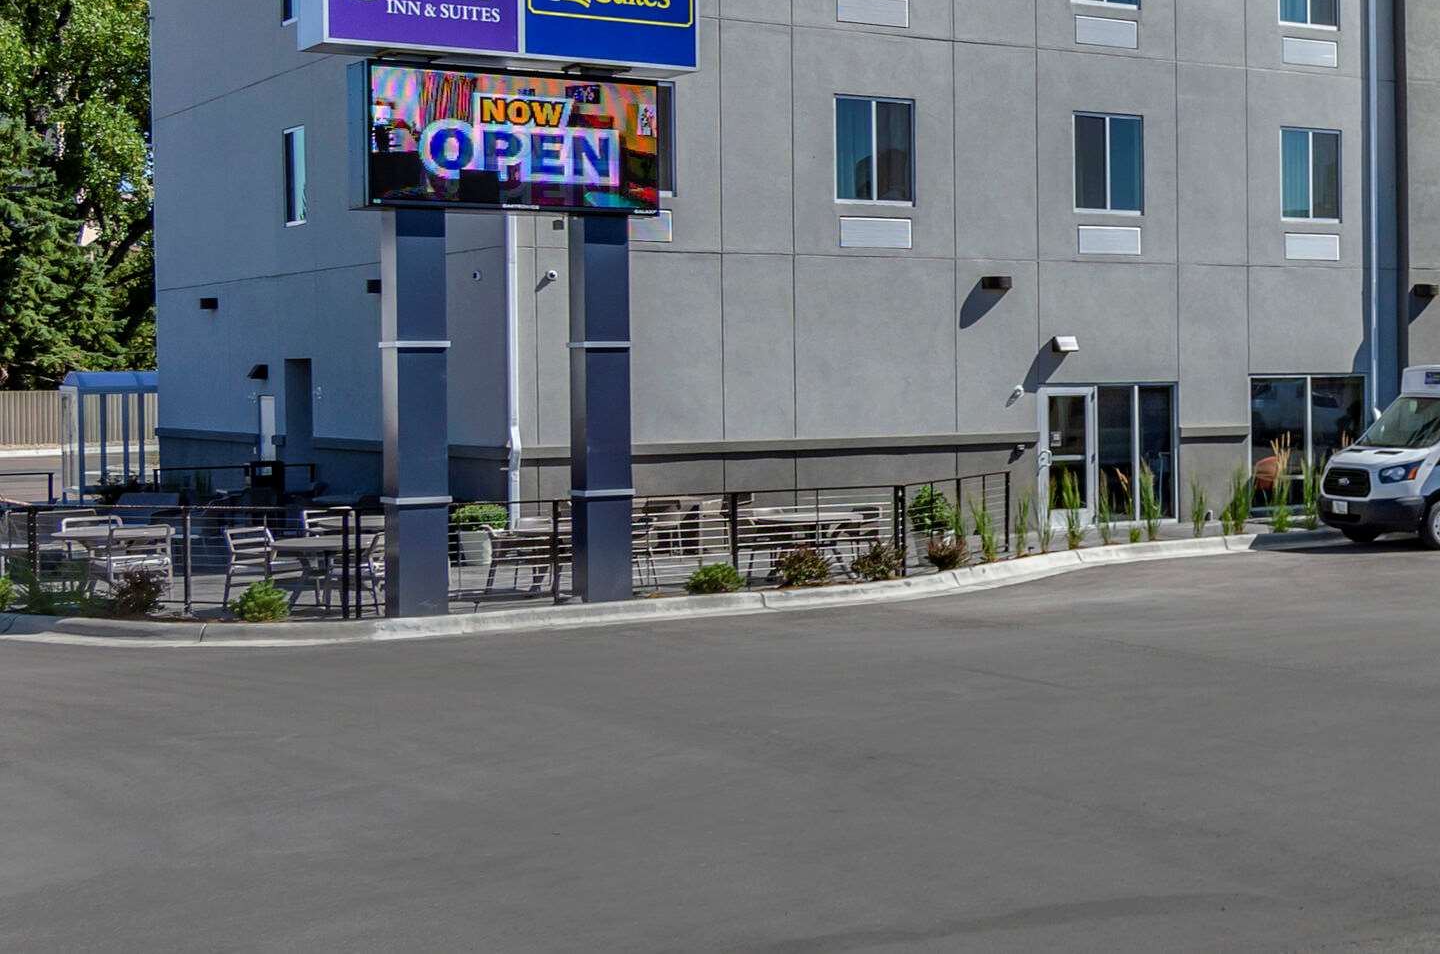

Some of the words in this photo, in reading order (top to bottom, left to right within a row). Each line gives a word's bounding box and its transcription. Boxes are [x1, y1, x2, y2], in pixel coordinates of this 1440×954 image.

[424, 3, 437, 18] &
[440, 3, 501, 24] SUITES
[480, 97, 566, 127] NOW
[426, 123, 614, 181] OPEN
